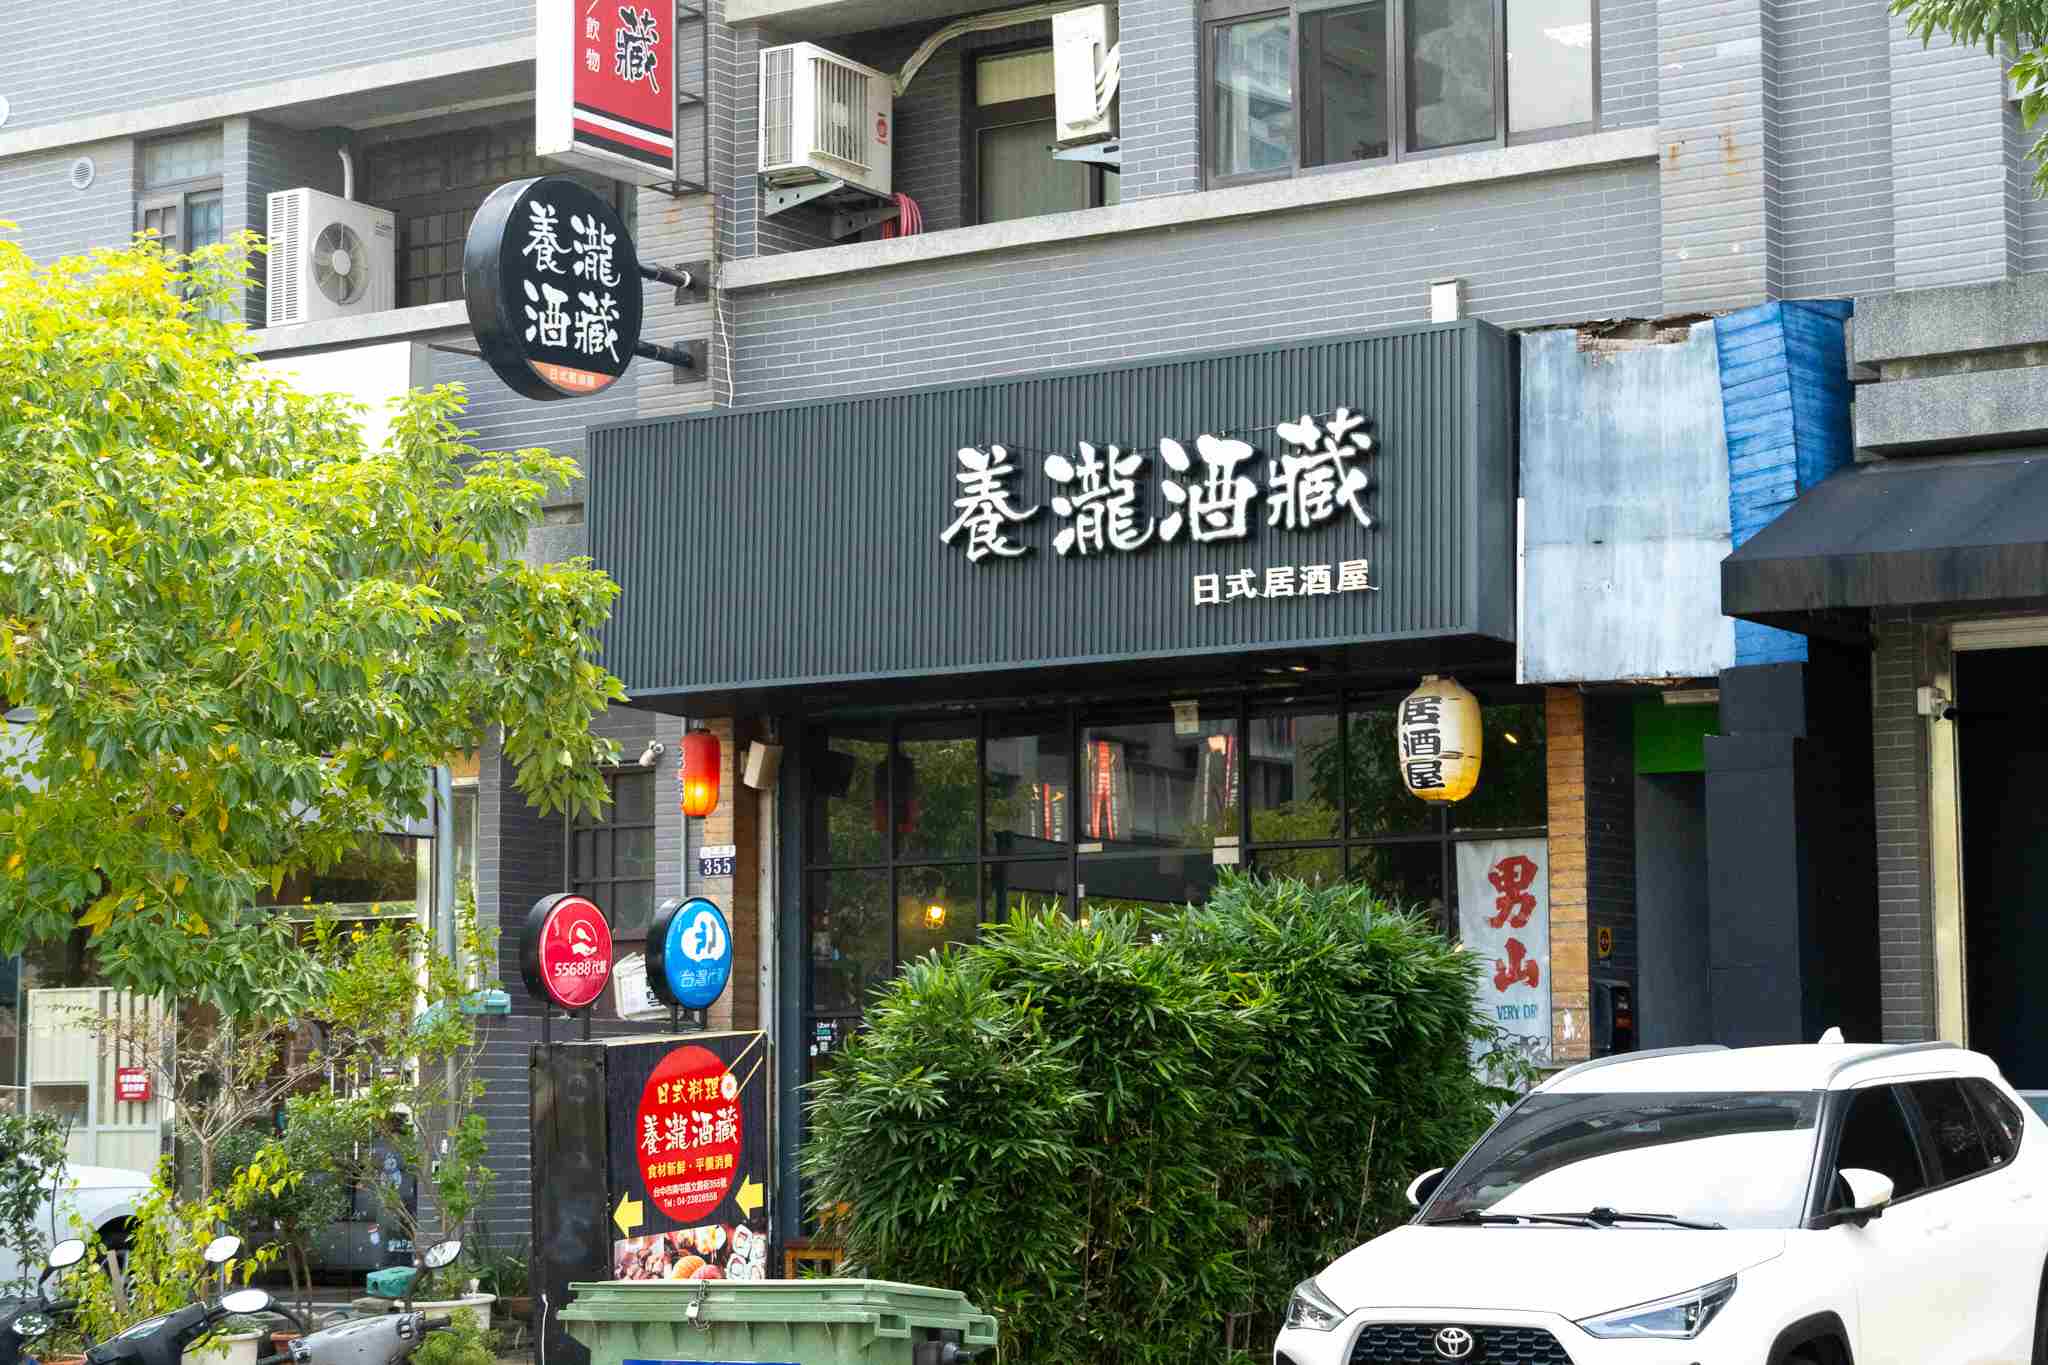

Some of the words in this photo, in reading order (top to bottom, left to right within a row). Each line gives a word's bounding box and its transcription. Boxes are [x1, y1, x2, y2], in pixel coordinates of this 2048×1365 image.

[940, 406, 1374, 563] 養瀧酒藏
[1193, 559, 1370, 606] 日式居酒屋
[1403, 696, 1445, 789] 居酒屋
[703, 857, 731, 875] 355
[1488, 854, 1540, 993] 男山
[1495, 1004, 1520, 1020] VERY
[657, 1076, 720, 1105] 日式料理
